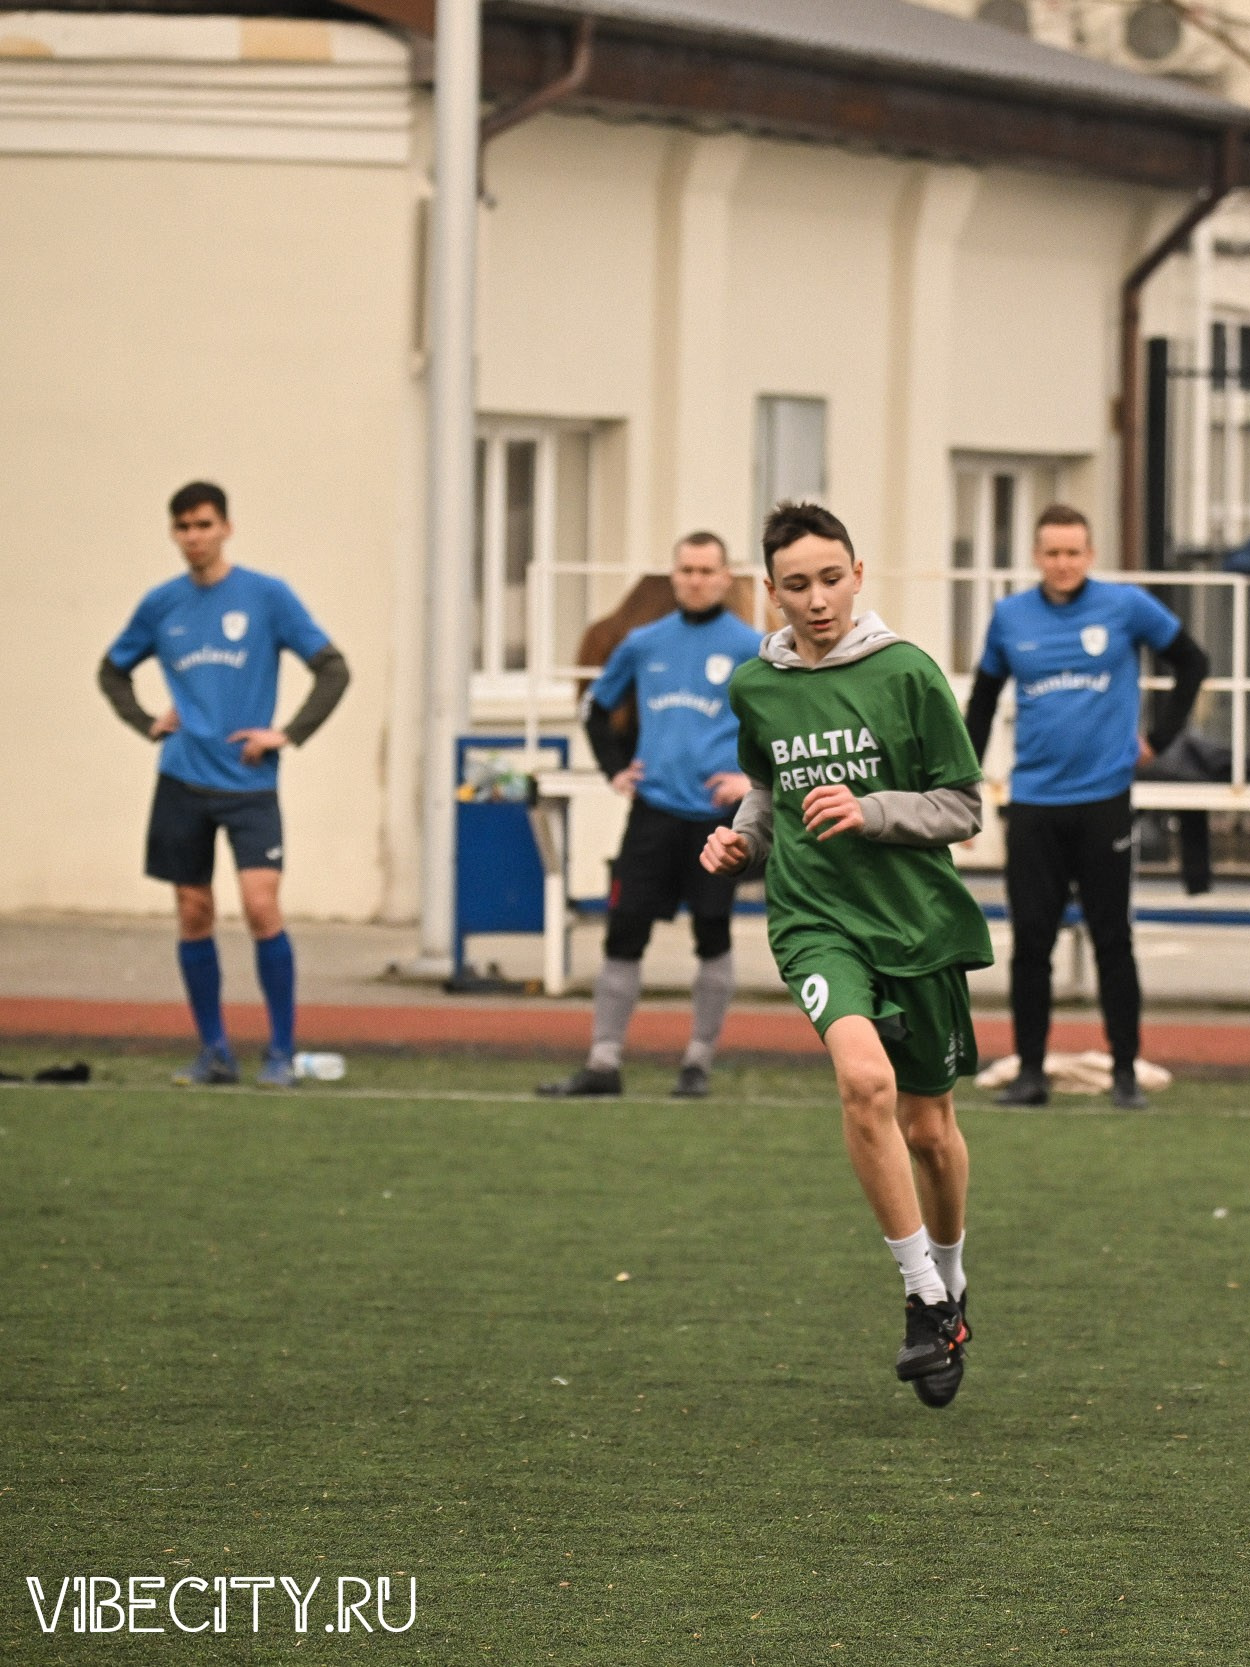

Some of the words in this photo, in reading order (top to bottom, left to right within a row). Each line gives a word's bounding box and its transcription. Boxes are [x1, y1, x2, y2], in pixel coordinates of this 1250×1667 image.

[771, 727, 879, 765] BALTIA
[780, 757, 881, 792] REMONT
[801, 973, 829, 1023] 9
